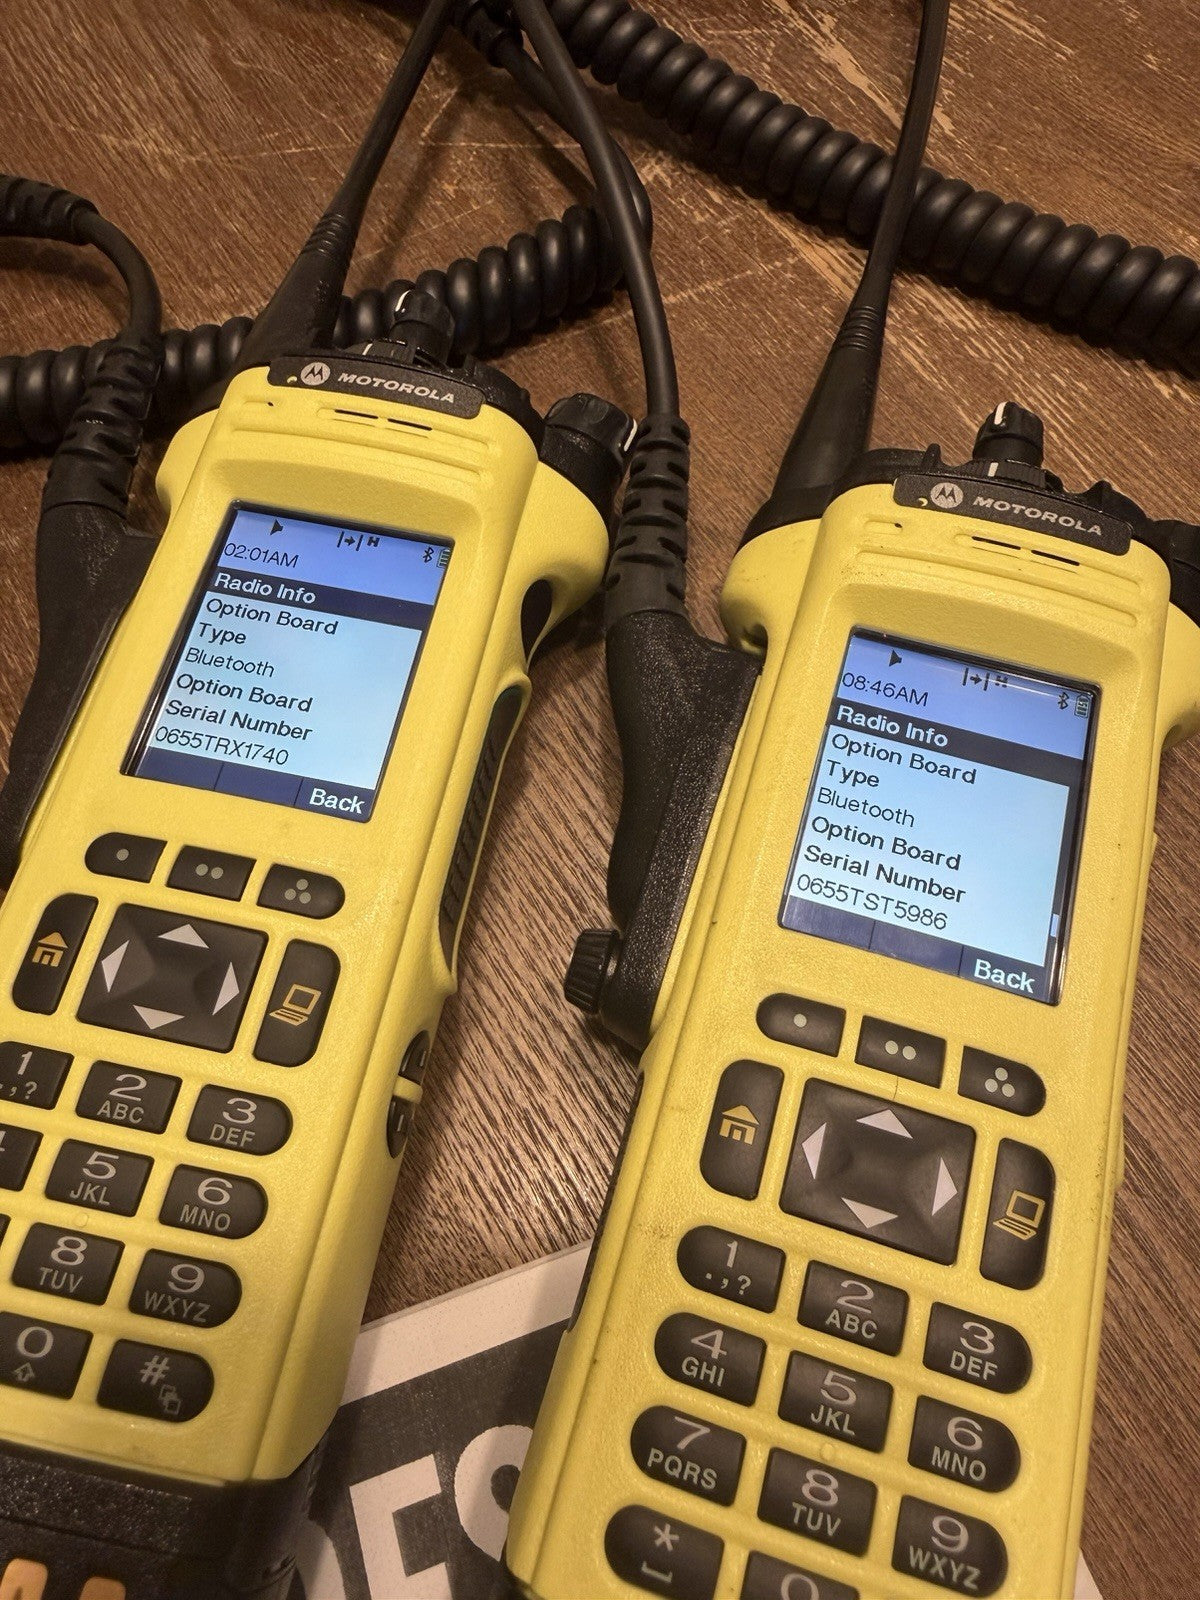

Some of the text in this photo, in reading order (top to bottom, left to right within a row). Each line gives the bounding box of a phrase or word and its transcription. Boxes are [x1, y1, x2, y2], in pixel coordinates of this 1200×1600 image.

[337, 372, 455, 404] MOTOROLA
[972, 495, 1102, 536] MOTOROLA
[223, 542, 299, 569] 02:01AM
[214, 571, 316, 605] Radio Info
[206, 597, 338, 635] Option Board
[198, 622, 247, 645] Type
[185, 646, 275, 678] Bluetooth
[176, 673, 313, 713] Option Board
[841, 671, 929, 707] 08:46AM
[165, 699, 313, 742] Serial Number
[836, 704, 949, 748] Radio Info
[155, 724, 289, 765] 0655TRX1740
[831, 733, 977, 785] Option Board
[826, 759, 880, 788] Type
[309, 787, 366, 815] Back
[817, 786, 915, 828] Bluetooth
[811, 815, 962, 870] Option Board
[804, 845, 966, 903] Serial Number
[797, 873, 949, 931] 0655TST5986
[974, 958, 1036, 994] Back
[17, 1051, 33, 1076] 1
[108, 1073, 148, 1101] 2
[97, 1100, 145, 1124] ABC
[222, 1097, 257, 1125] 3
[209, 1123, 256, 1148] DEF
[82, 1151, 120, 1180] 5
[70, 1181, 111, 1206] JKL
[197, 1177, 234, 1206] 6
[180, 1203, 232, 1232] MNO
[50, 1235, 88, 1266] 8
[726, 1240, 740, 1269] 1
[39, 1267, 84, 1293] TUV
[167, 1263, 206, 1294] 9
[144, 1290, 211, 1323] WXYZ
[836, 1279, 875, 1315] 2
[825, 1308, 879, 1341] ABC
[959, 1321, 996, 1356] 3
[690, 1329, 728, 1361] 4
[681, 1356, 725, 1388] GHI
[949, 1350, 999, 1382] DEF
[820, 1369, 858, 1407] 5
[672, 1416, 711, 1451] 7
[810, 1405, 855, 1437] JKL
[947, 1416, 983, 1452] 6
[647, 1447, 719, 1491] PQRS
[931, 1446, 988, 1483] MNO
[801, 1468, 840, 1507] 8
[791, 1502, 842, 1537] TUV
[931, 1515, 969, 1553] 9
[908, 1545, 982, 1591] WXYZ
